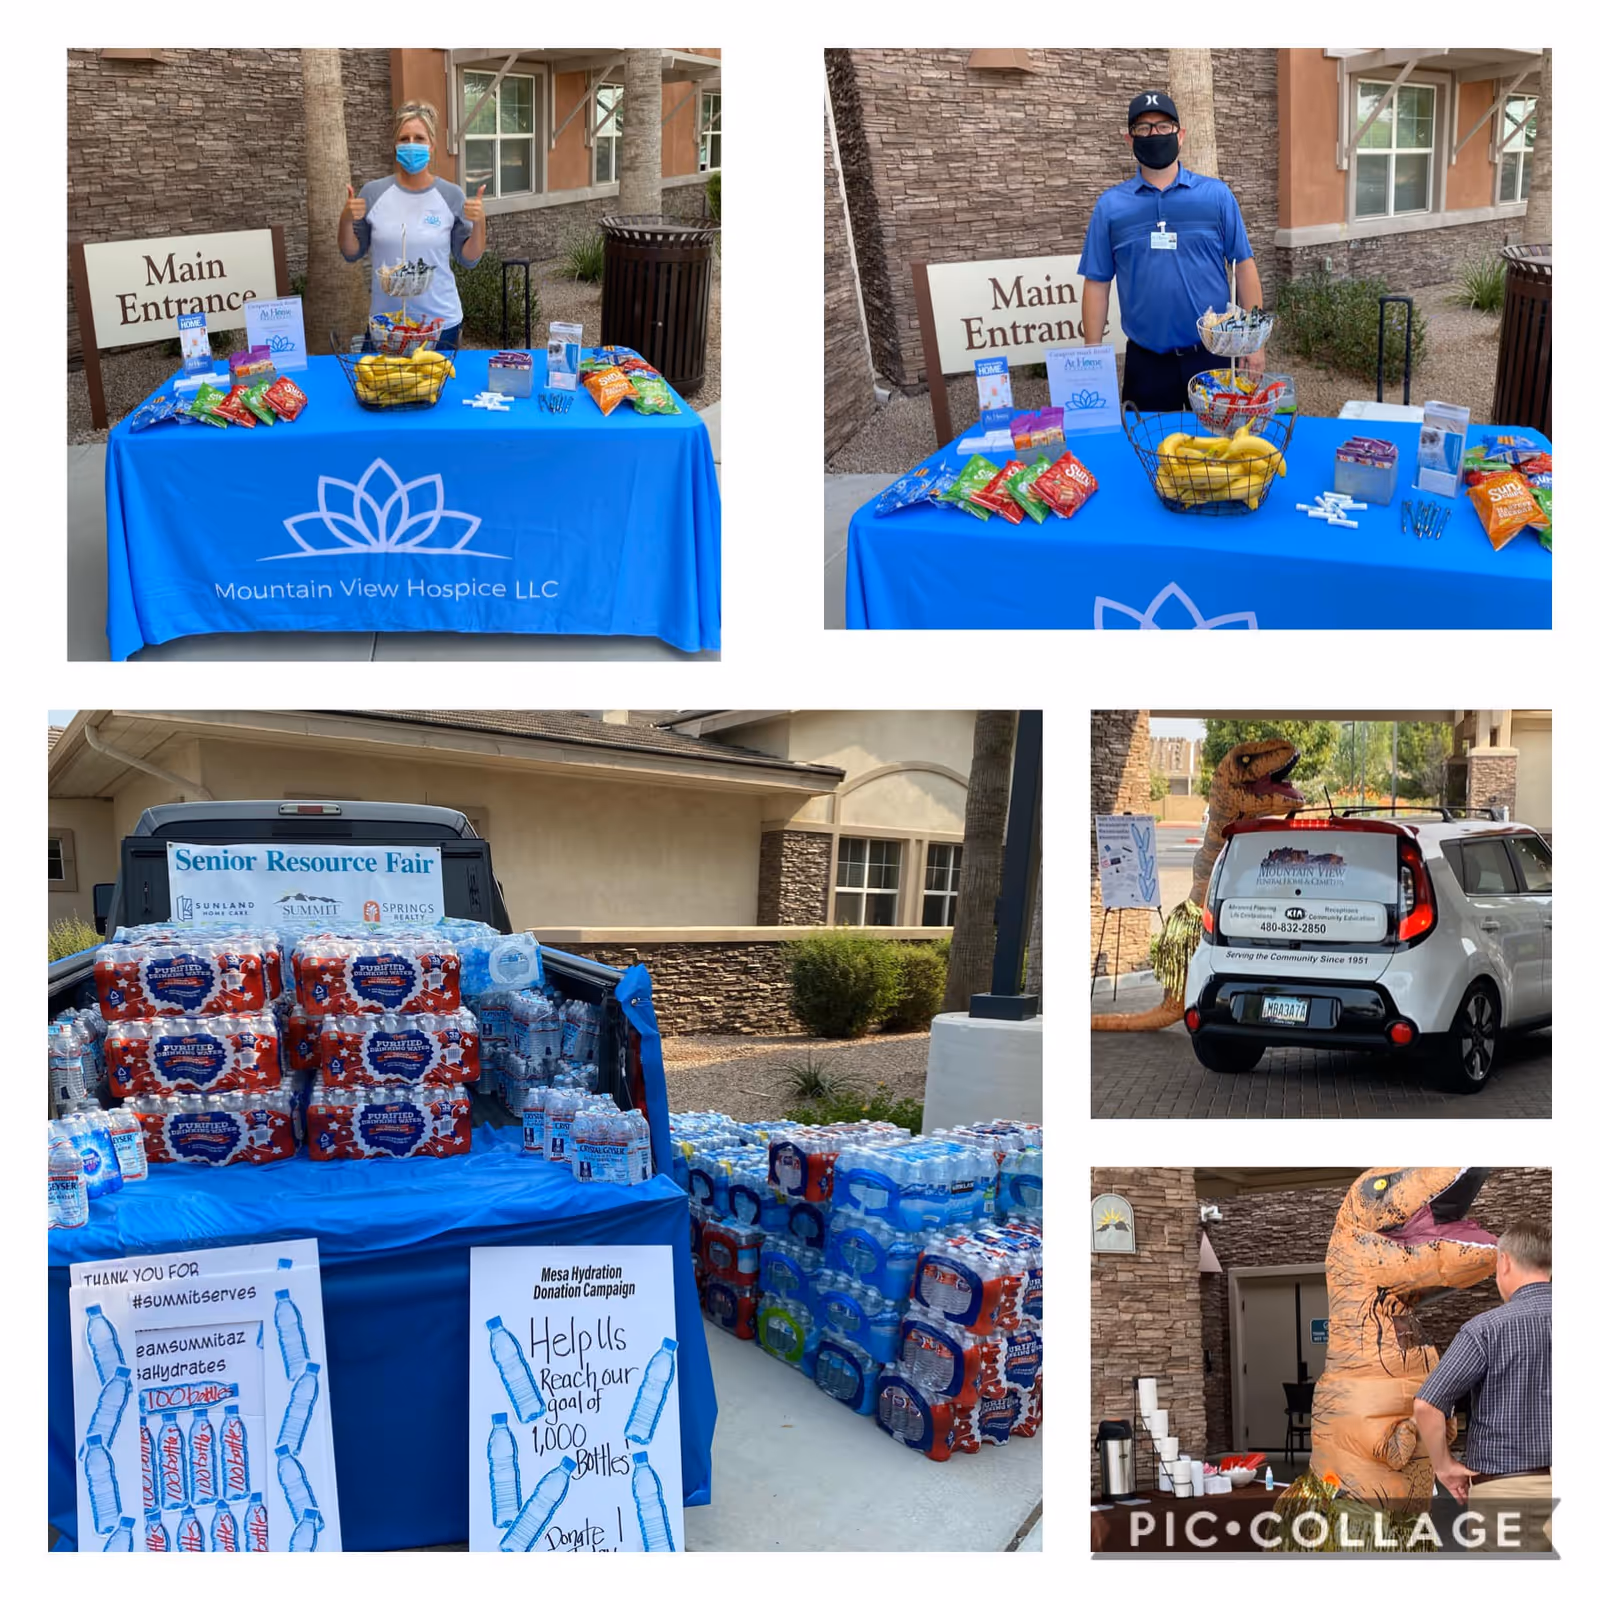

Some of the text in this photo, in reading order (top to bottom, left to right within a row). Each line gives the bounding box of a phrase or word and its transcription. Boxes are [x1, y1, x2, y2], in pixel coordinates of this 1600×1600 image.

[143, 251, 227, 286] Main
[988, 274, 1078, 310] Main
[116, 289, 257, 325] Entrance
[214, 578, 559, 602] Mountain View Hospice LLC
[175, 849, 434, 874] Senior Resource Fair
[1258, 865, 1346, 878] MOUNTAIN VIEW
[1256, 877, 1284, 886] FUNERAL
[195, 901, 255, 910] SUNLAND
[282, 904, 340, 916] SUMMIT
[382, 902, 434, 914] SPRINGS
[394, 913, 425, 921] REALTY
[1286, 908, 1303, 919] KIA
[1308, 913, 1375, 923] Community Education
[1260, 921, 1327, 934] 480-832-2850
[1225, 950, 1369, 965] Serving the Community Since 1951
[154, 964, 202, 974] PURIFIED
[359, 963, 406, 972] PURIFIED
[163, 1043, 214, 1051] PURIFIED
[367, 1112, 414, 1120] PURIFIED
[178, 1121, 229, 1129] PURIFIED
[84, 1261, 200, 1288] THANK YOU FOR
[541, 1264, 622, 1282] Mesa Hydration
[533, 1281, 635, 1300] Donation Campaign
[531, 1315, 627, 1369] Help Us
[540, 1362, 639, 1396] Reach our
[546, 1388, 604, 1426] goal of
[532, 1423, 587, 1456] 1,000
[545, 1517, 605, 1551] Donate
